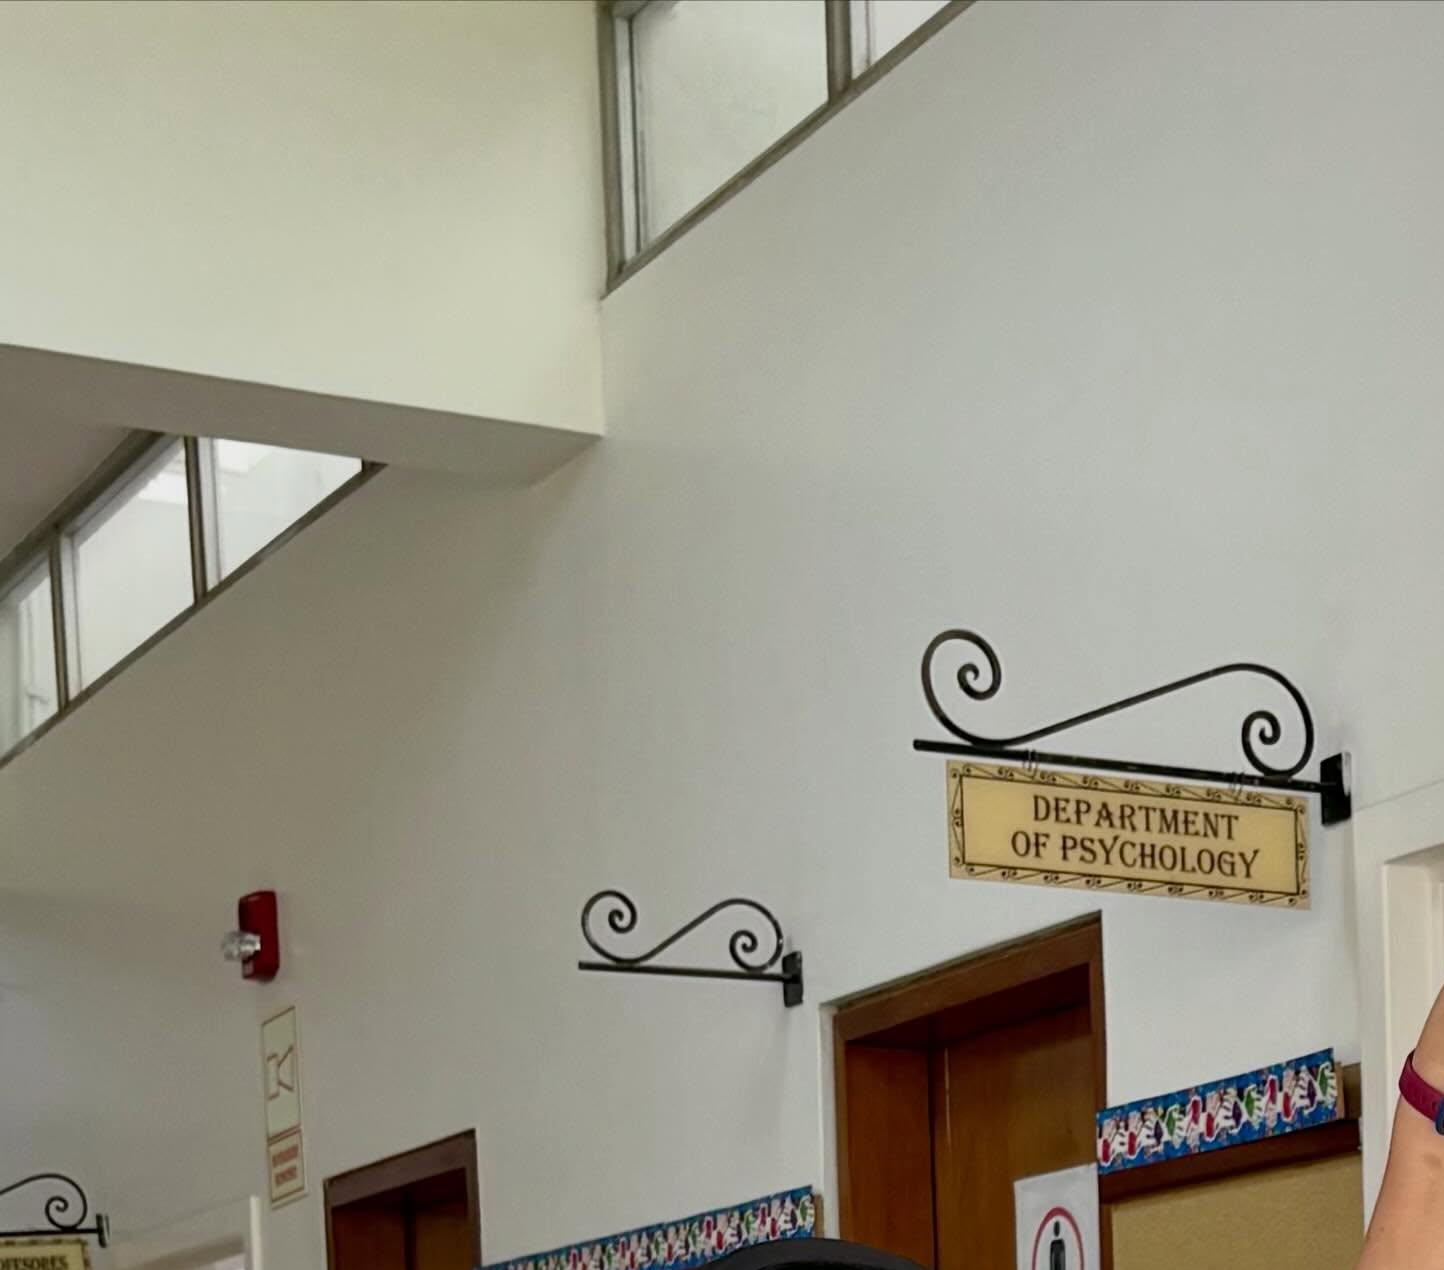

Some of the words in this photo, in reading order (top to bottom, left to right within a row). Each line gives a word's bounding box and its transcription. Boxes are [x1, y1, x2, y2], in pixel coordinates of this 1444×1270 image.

[1033, 794, 1240, 841] DEPARTMENT
[1011, 830, 1051, 861] OF
[1060, 834, 1261, 879] PSYCHOLOGY
